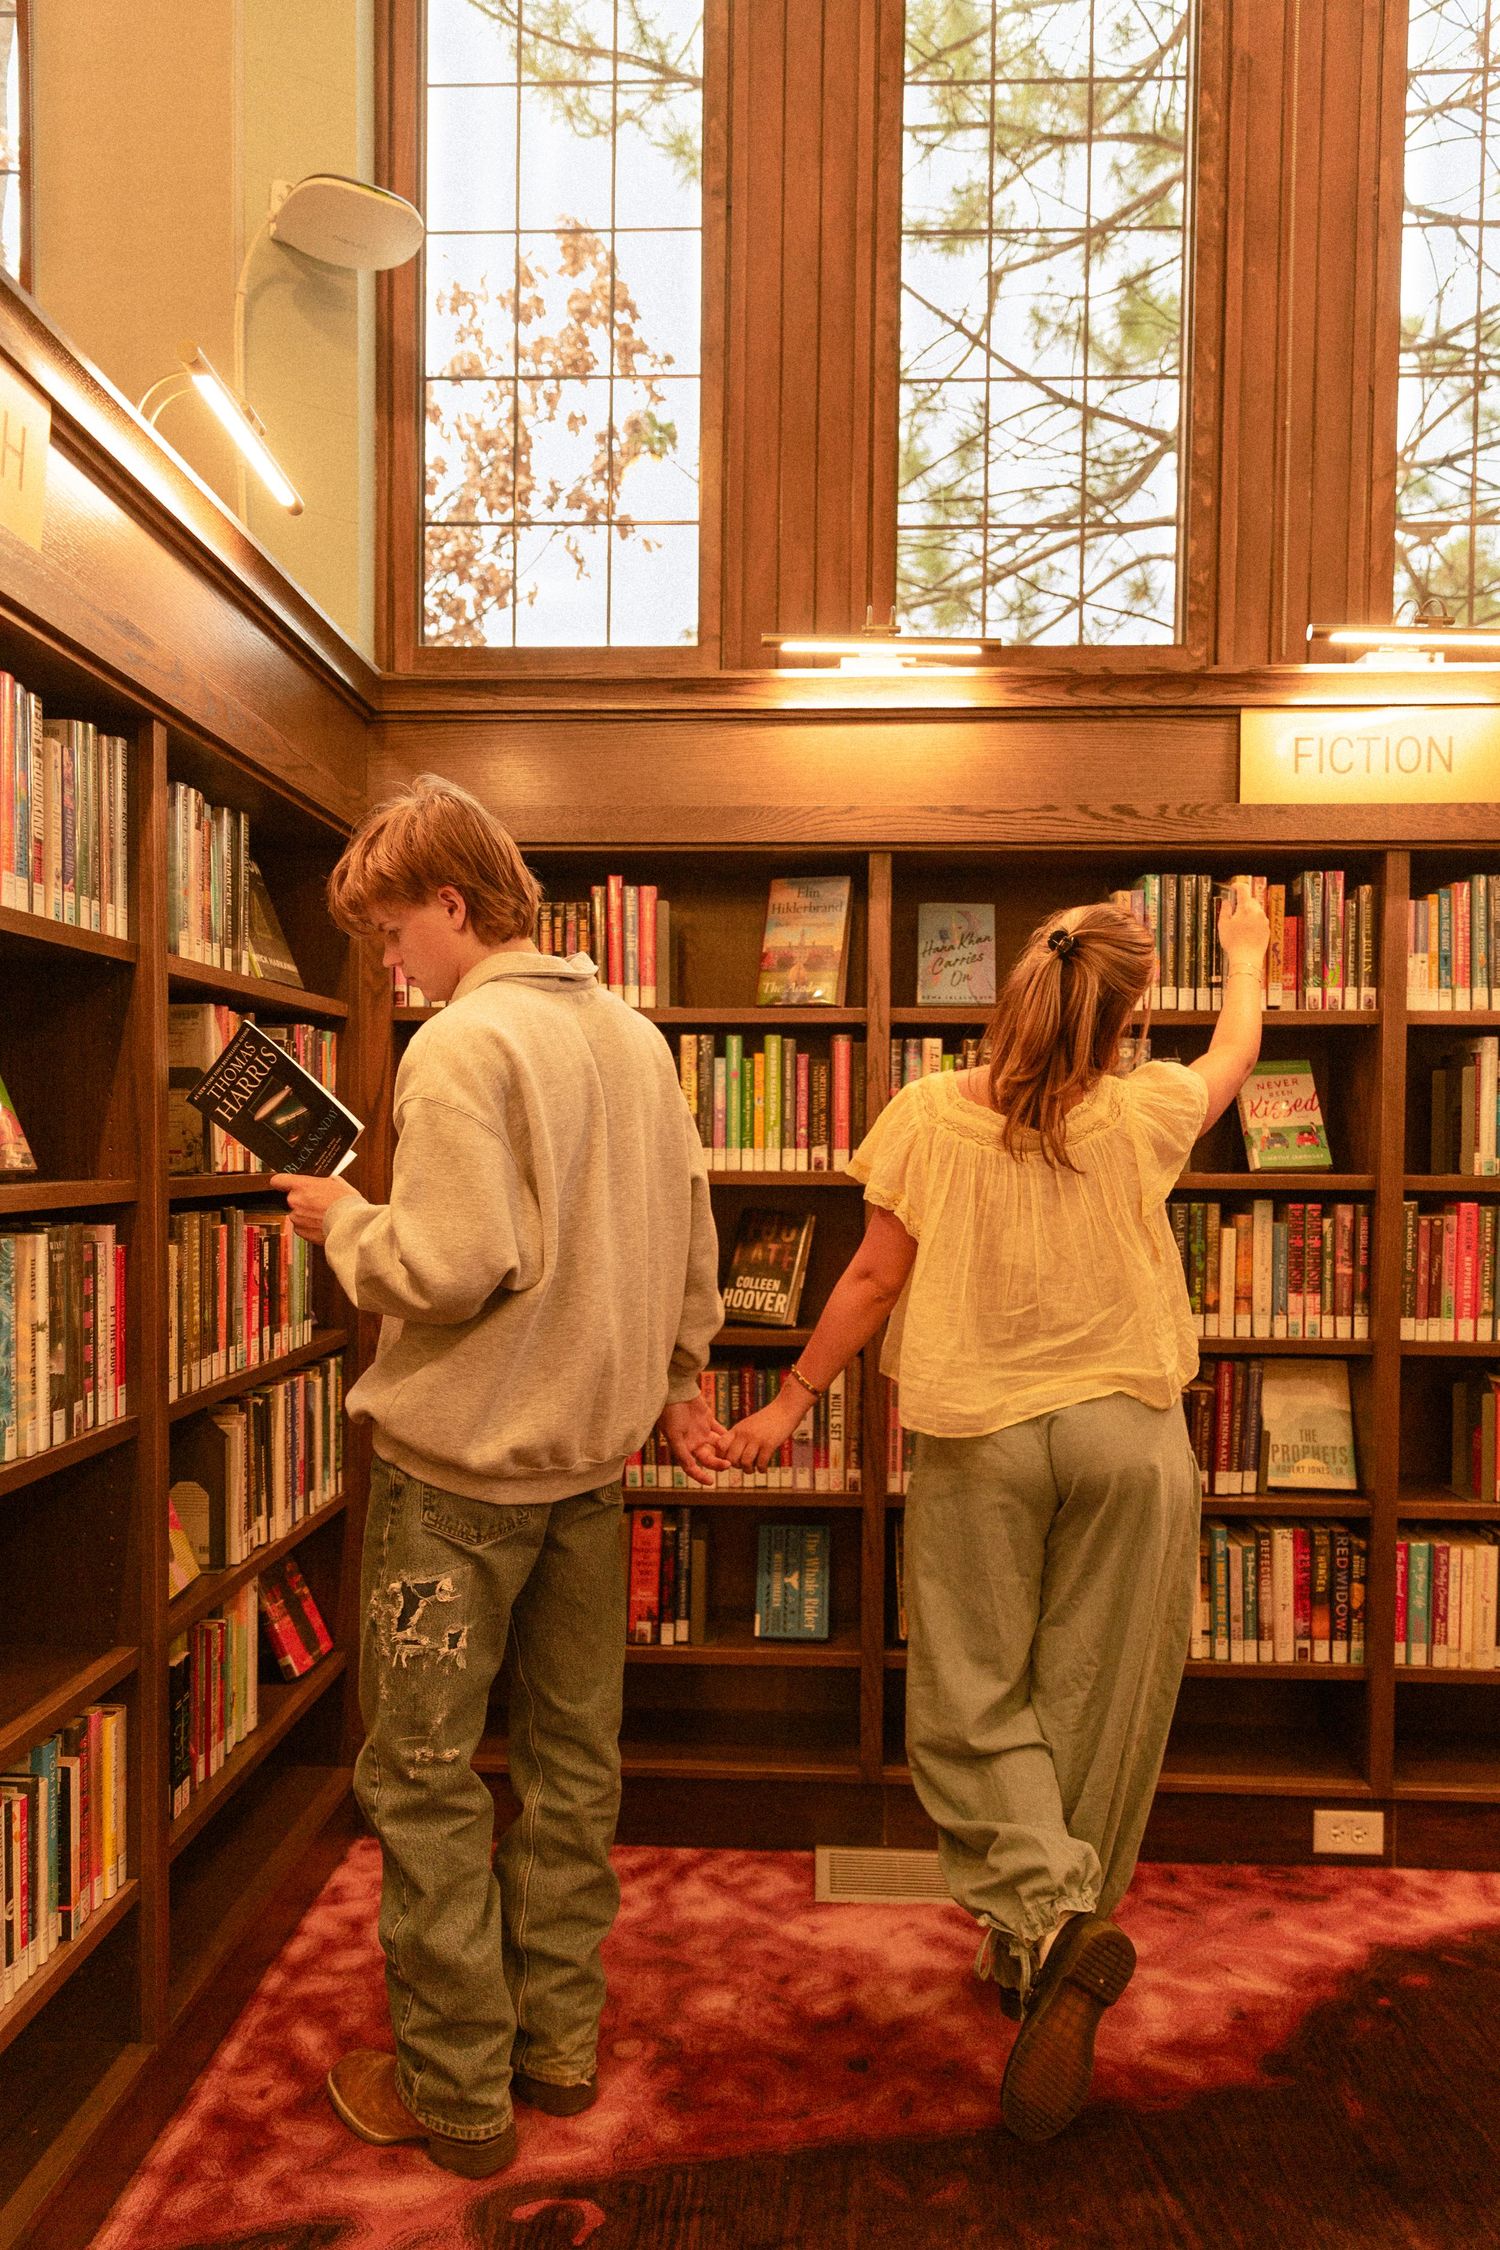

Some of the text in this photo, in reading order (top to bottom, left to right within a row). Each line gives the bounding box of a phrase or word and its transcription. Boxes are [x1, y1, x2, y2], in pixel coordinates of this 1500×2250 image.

[1293, 735, 1453, 774] FICTION
[33, 755, 44, 841] GOODKIND
[797, 886, 820, 898] Elin
[1441, 897, 1451, 917] ZORBA
[771, 900, 843, 915] Hilderbrand
[958, 931, 992, 950] Khan
[1363, 902, 1373, 973] BRIGHT RUIN
[1479, 910, 1487, 956] HALF MOON
[931, 952, 984, 975] Carries
[950, 970, 973, 987] On
[221, 1043, 240, 1066] BESTSELLING
[207, 1041, 257, 1101] THOMAS
[214, 1046, 278, 1124] HARRIS
[1256, 1078, 1299, 1090] NEVER
[819, 1065, 828, 1110] NORTHERN
[1269, 1089, 1293, 1097] BEEN
[1249, 1091, 1319, 1120] Kissed
[283, 1144, 315, 1176] BLACK
[308, 1107, 339, 1147] SUNDAY
[1176, 1209, 1185, 1229] LISA
[1196, 1209, 1204, 1250] WATCHING
[1484, 1211, 1492, 1242] BEASTS
[1325, 1226, 1333, 1252] Sisters
[1359, 1216, 1368, 1266] MIRRORLAND
[1405, 1210, 1414, 1271] SUE MONK KIDD
[192, 1218, 200, 1335] TERRY HAYES
[735, 1275, 781, 1291] COLLEEN
[1195, 1277, 1203, 1293] LISA
[1324, 1258, 1333, 1311] Daisy Johnson
[1463, 1256, 1472, 1299] HAPPINESS
[1484, 1259, 1492, 1285] LITTLE
[723, 1287, 787, 1314] HOOVER
[1484, 1287, 1492, 1310] LAND
[109, 1346, 117, 1376] BOOK
[731, 1385, 740, 1410] BEACON
[831, 1393, 842, 1442] NULL SET
[1220, 1413, 1229, 1446] HENNA
[1299, 1429, 1318, 1443] THE
[1271, 1444, 1348, 1466] PROPHETS
[803, 1531, 821, 1632] The Whale Rider
[1260, 1539, 1271, 1601] DEFECTORS
[1316, 1556, 1326, 1593] HUNTER
[1336, 1536, 1349, 1631] RED WIDOW
[1436, 1566, 1448, 1586] Party
